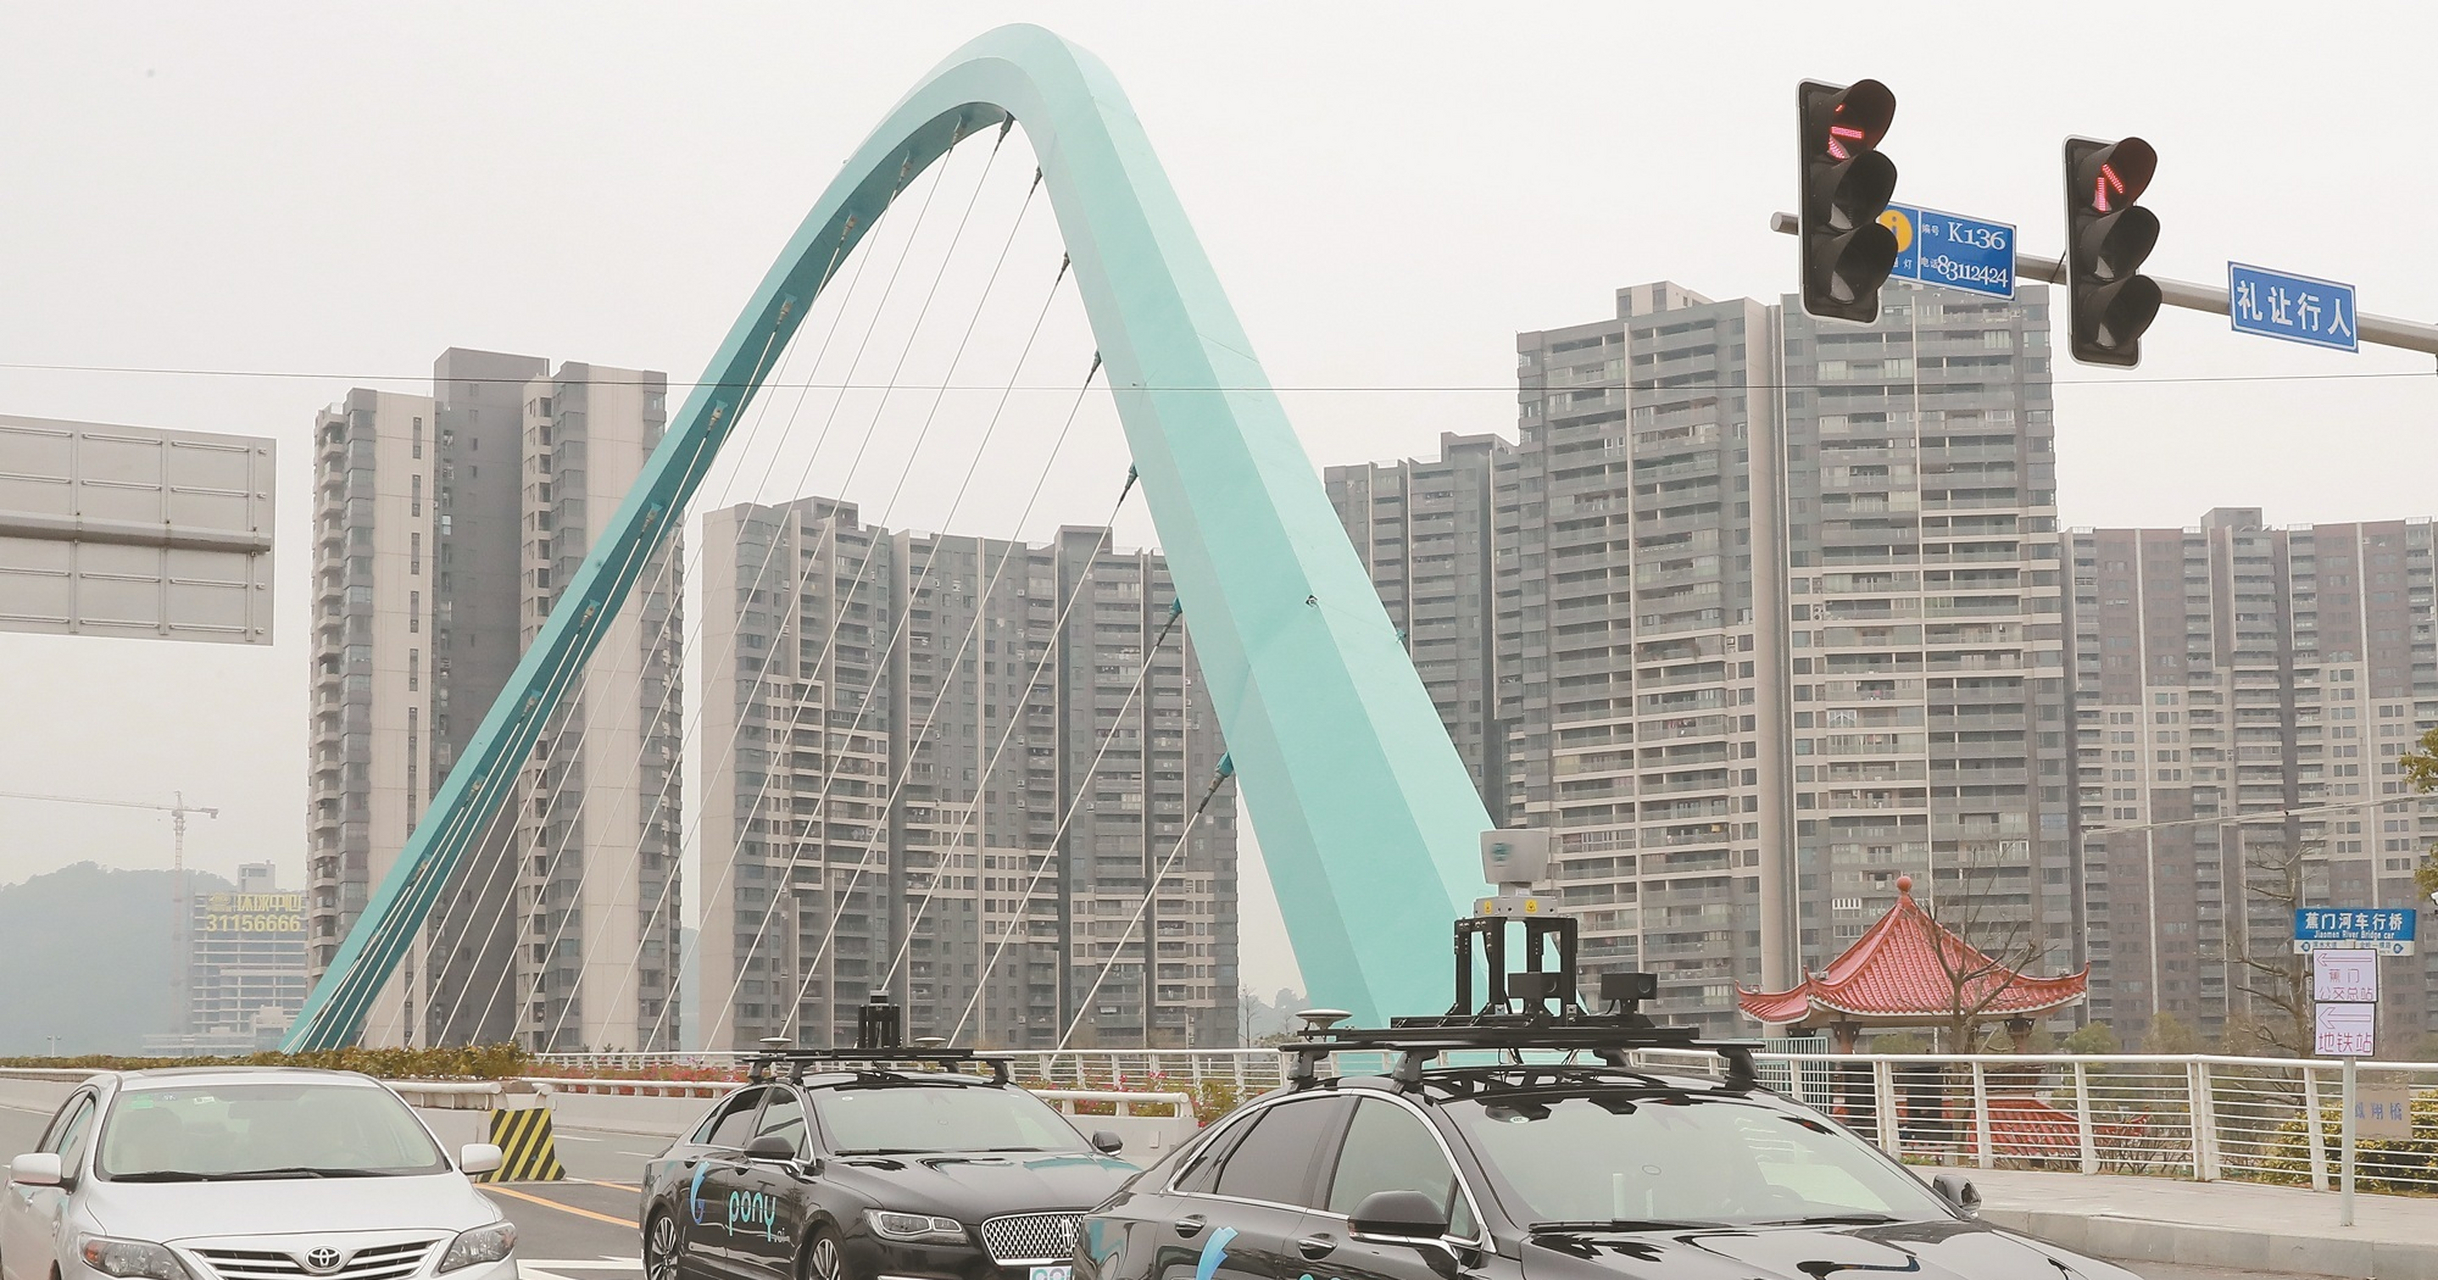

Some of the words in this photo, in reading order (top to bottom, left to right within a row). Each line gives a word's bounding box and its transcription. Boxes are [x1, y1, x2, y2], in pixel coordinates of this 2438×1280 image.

[1947, 221, 2006, 251] K136
[1937, 254, 2008, 288] 83112424
[2237, 280, 2352, 338] 礼让行人
[206, 913, 301, 932] 31156666
[2305, 911, 2403, 931] 蕉门河车行桥
[2342, 930, 2359, 938] River
[2360, 930, 2381, 941] Bridge
[2319, 986, 2373, 1001] 公交总站
[2318, 1032, 2373, 1054] 地铁站
[729, 1190, 776, 1242] pony
